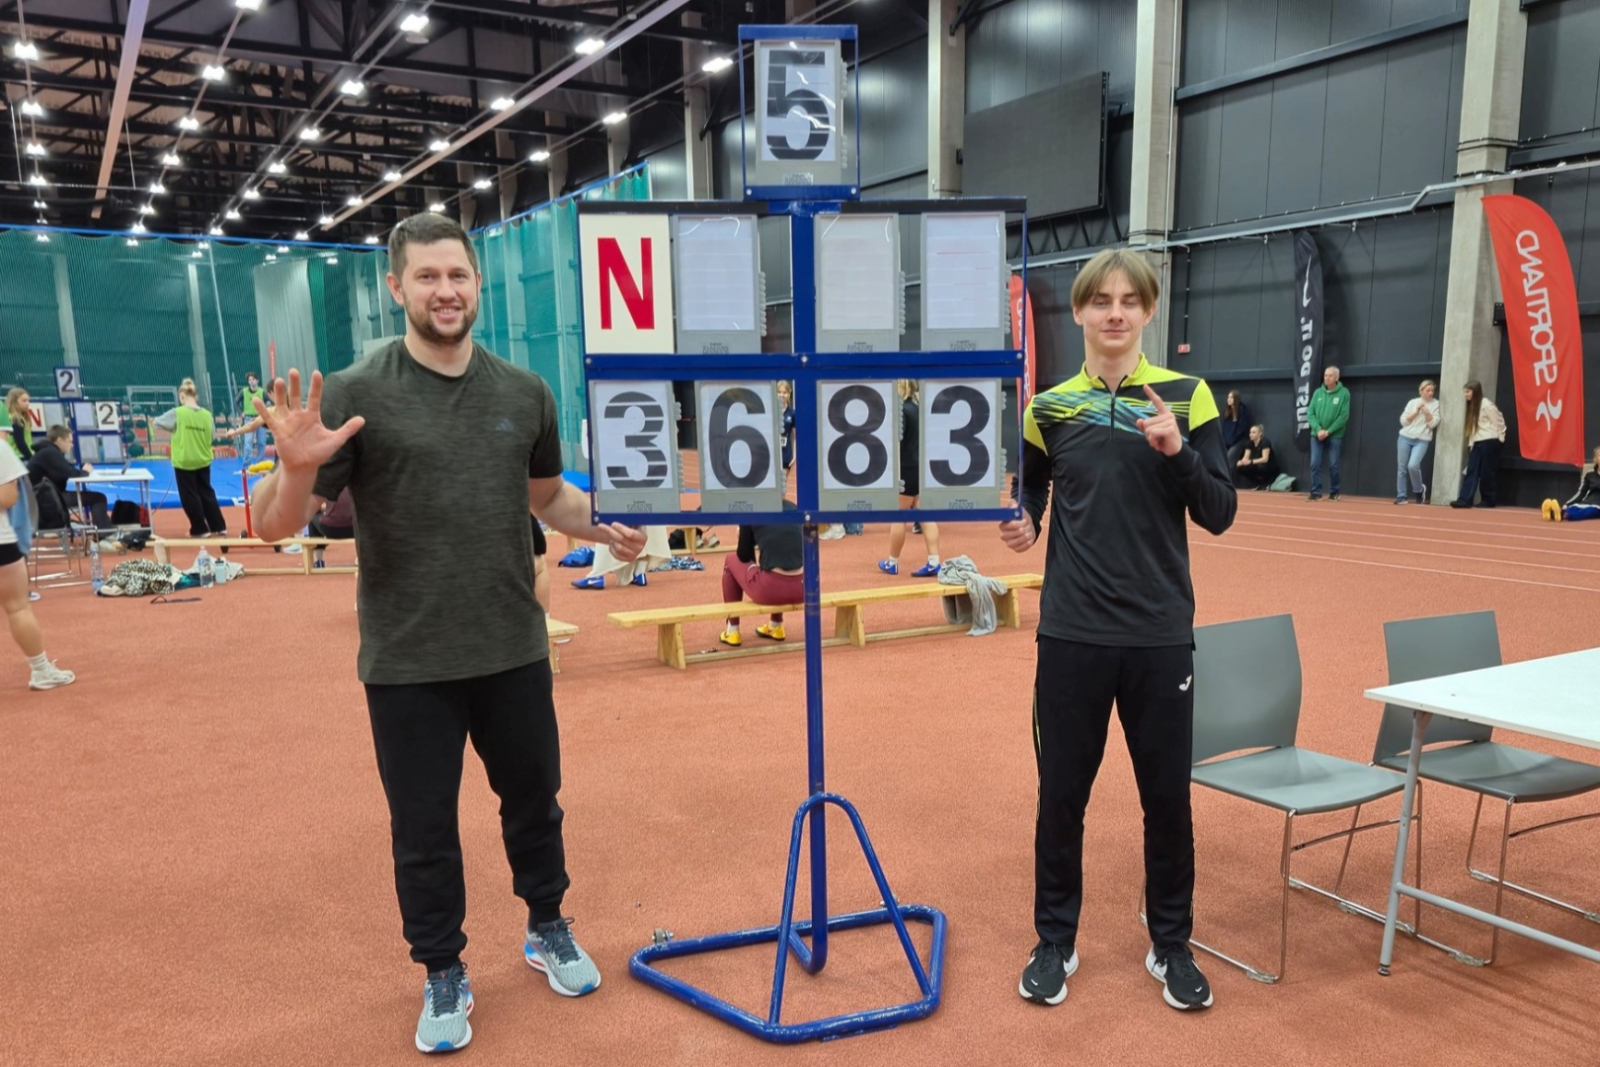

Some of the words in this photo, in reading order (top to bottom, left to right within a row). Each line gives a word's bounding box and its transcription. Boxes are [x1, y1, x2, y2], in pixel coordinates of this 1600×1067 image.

[766, 50, 830, 162] 5
[597, 237, 655, 331] N
[59, 371, 75, 393] 2
[98, 404, 115, 425] 2
[604, 391, 668, 489] 3
[708, 387, 771, 488] 6
[827, 385, 888, 487] 8
[930, 385, 991, 486] 3
